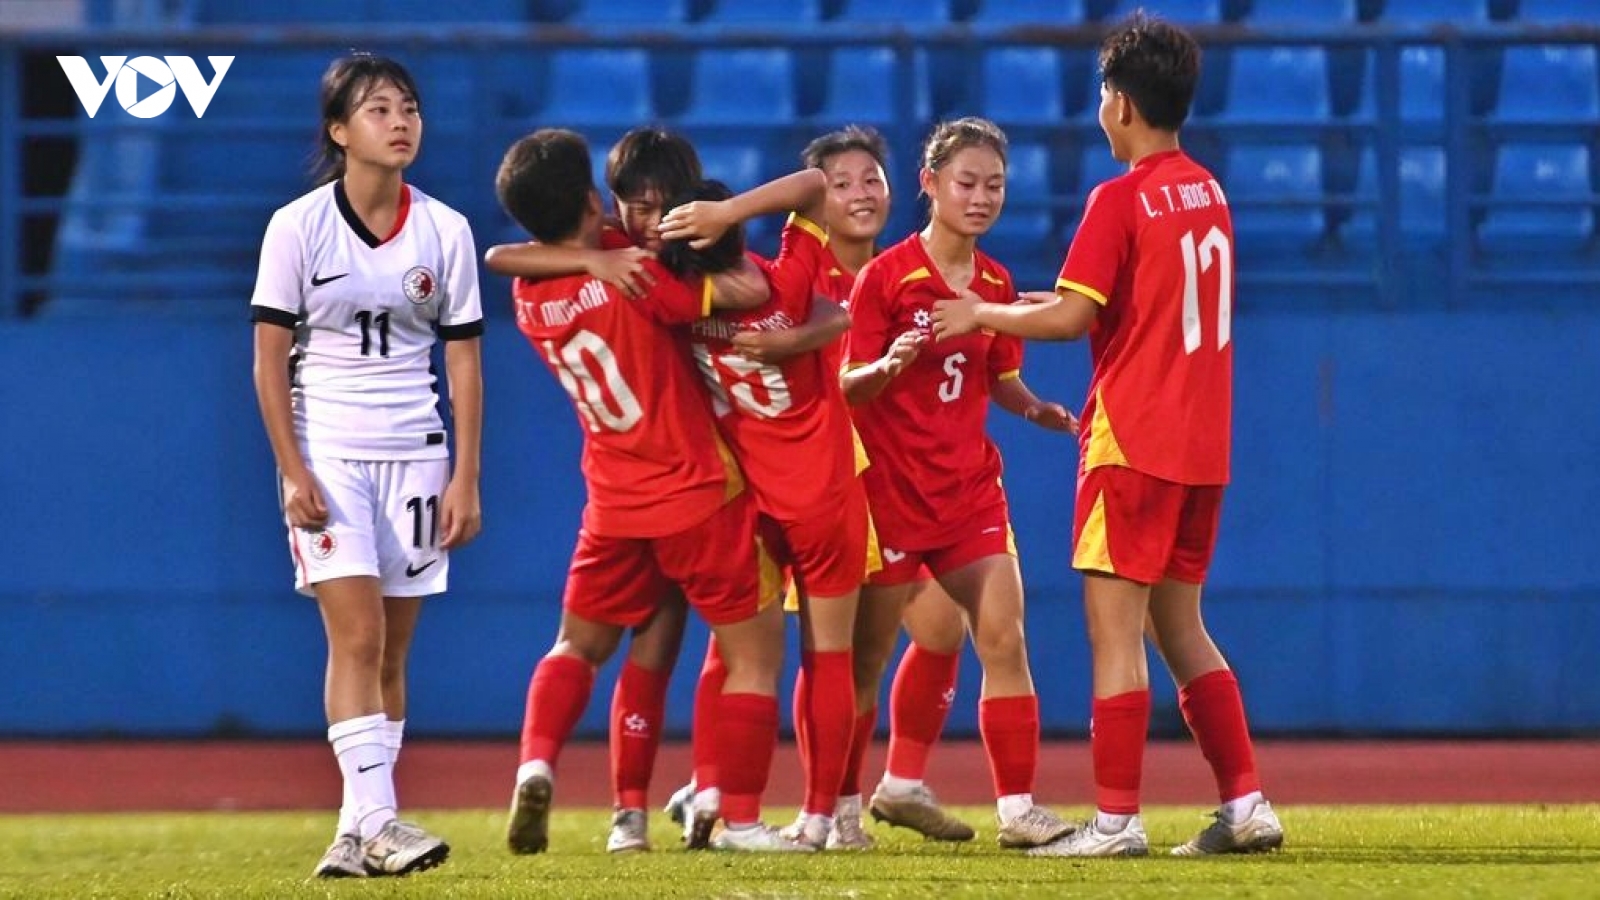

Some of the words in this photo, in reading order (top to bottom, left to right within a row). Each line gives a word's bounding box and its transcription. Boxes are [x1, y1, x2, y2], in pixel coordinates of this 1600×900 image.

[1139, 191, 1163, 218] L.
[1160, 185, 1182, 213] T.
[1179, 225, 1232, 356] 17
[354, 310, 390, 357] 11
[541, 329, 644, 434] 10
[690, 343, 792, 420] 15
[406, 494, 439, 549] 11
